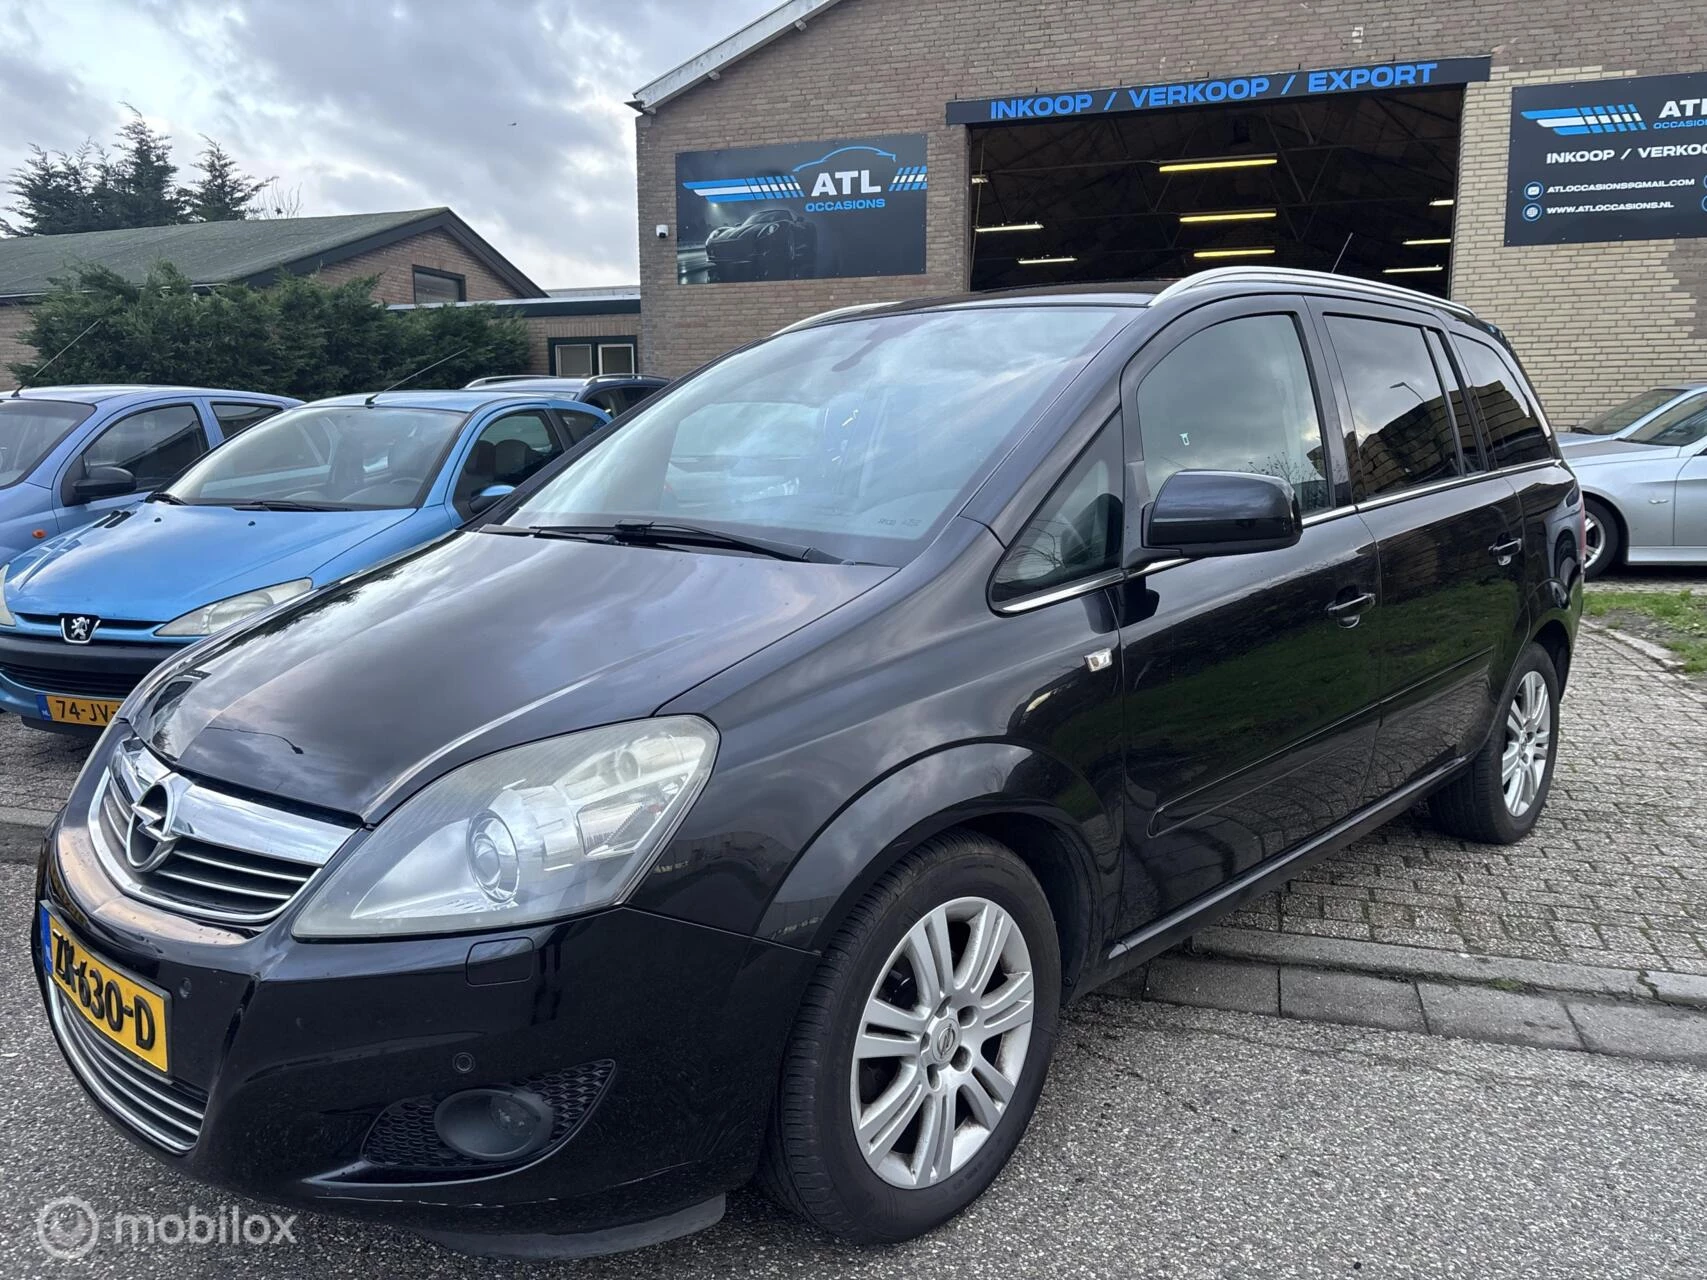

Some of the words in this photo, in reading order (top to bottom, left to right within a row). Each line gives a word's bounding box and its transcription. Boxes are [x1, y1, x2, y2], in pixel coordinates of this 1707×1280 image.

[991, 94, 1093, 119] INKOOP
[1104, 91, 1117, 111] /
[1128, 77, 1270, 108] VERKOOP
[1281, 75, 1296, 95] /
[1308, 63, 1438, 93] EXPORT
[1653, 119, 1707, 129] OCCASIO
[1546, 149, 1615, 164] INKOOP
[1620, 148, 1632, 160] /
[811, 170, 881, 196] ATL
[805, 198, 886, 212] OCCASIONS
[1547, 201, 1674, 214] WWW.ATLOCCASIONS.NL
[56, 700, 119, 722] 74-JV-
